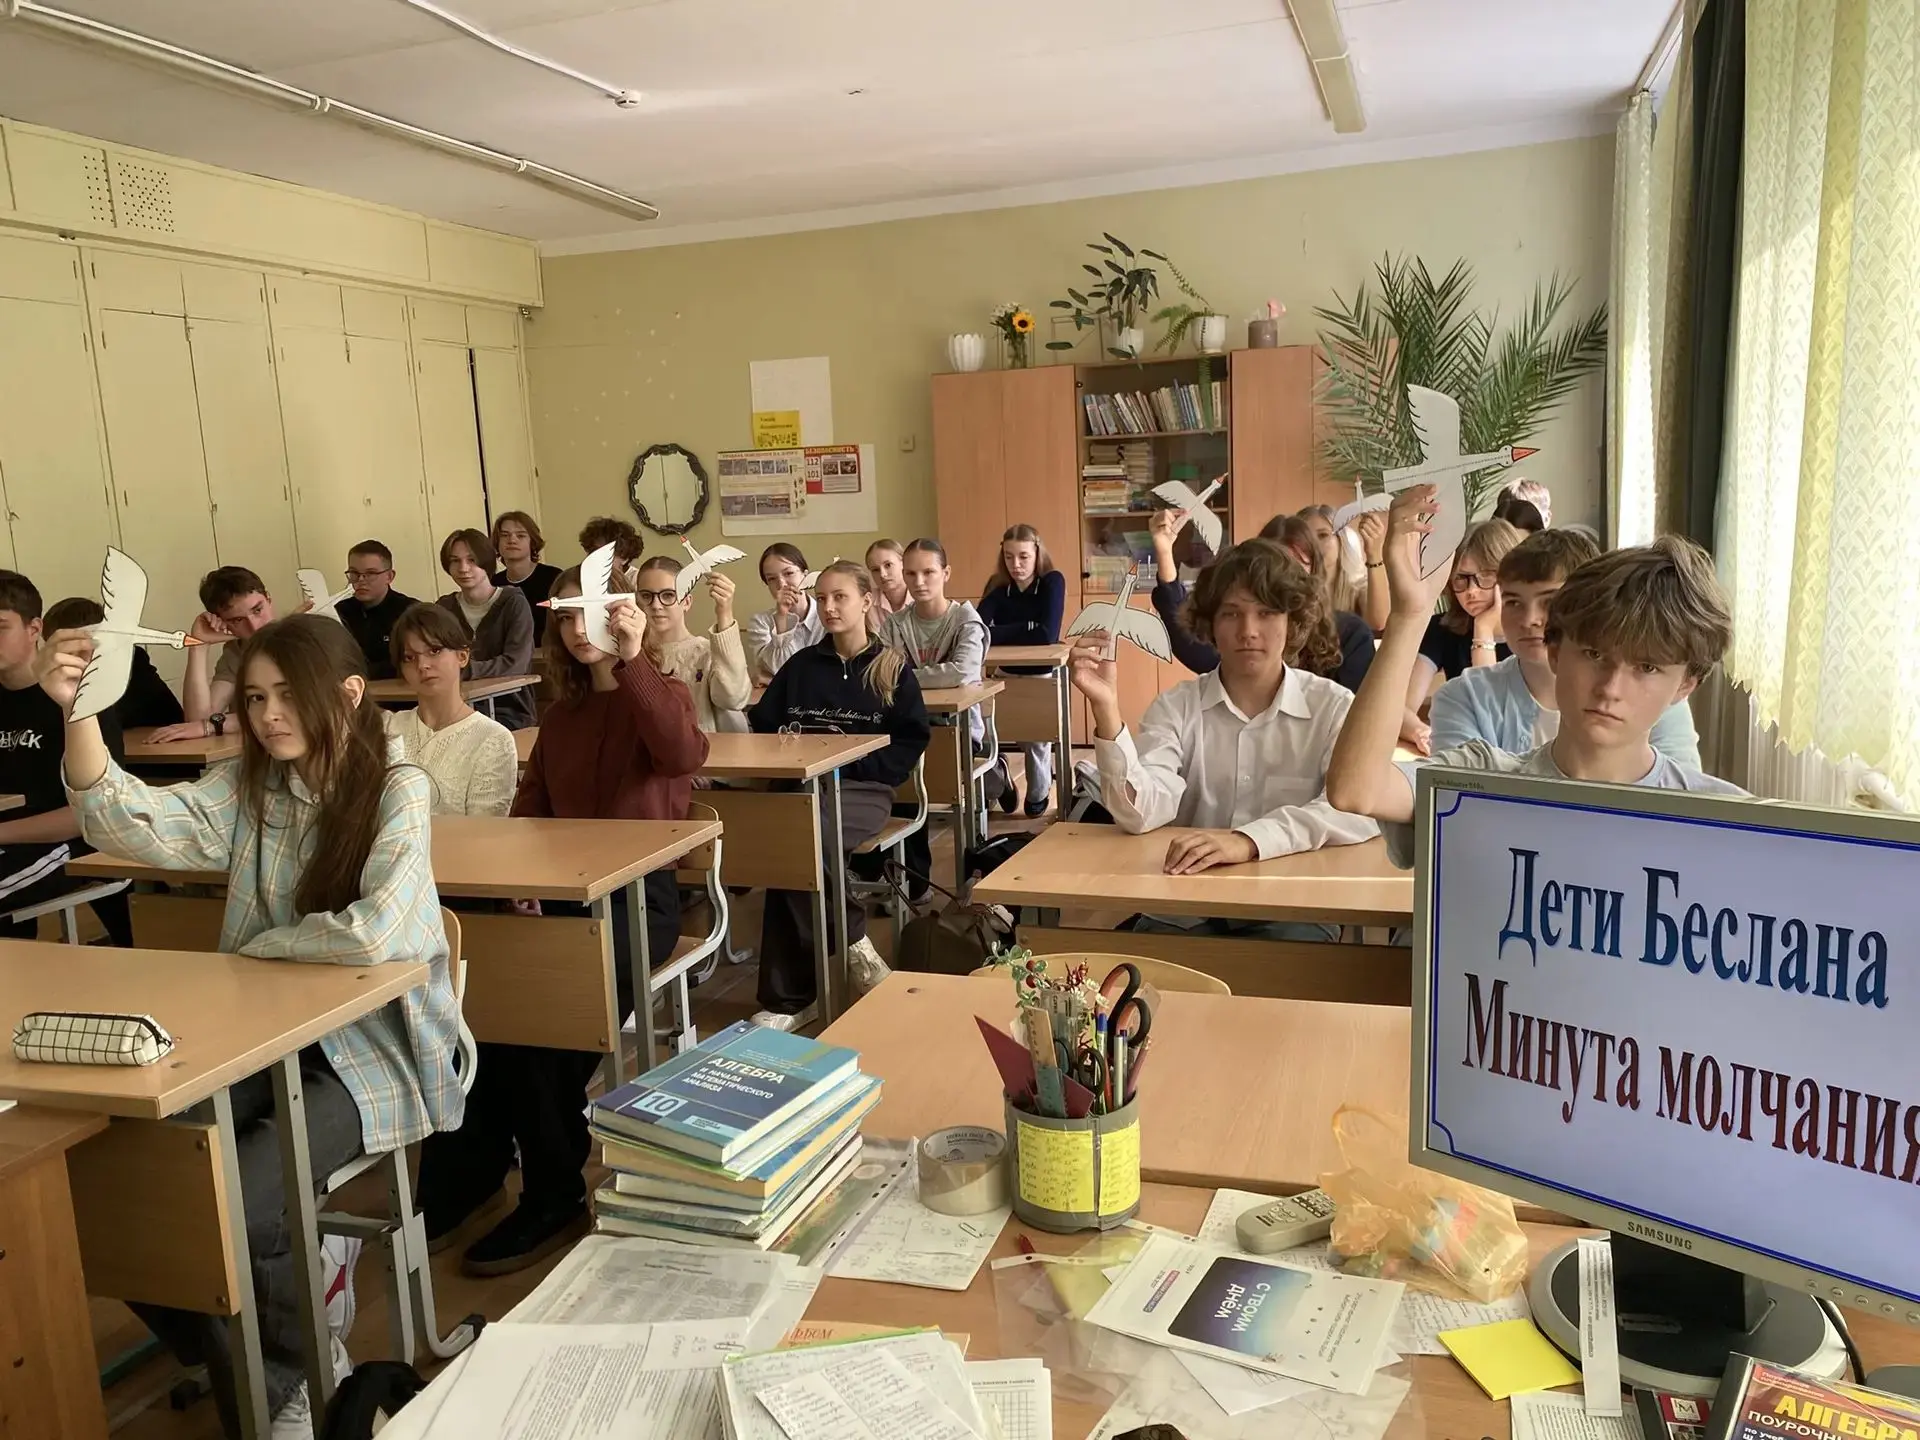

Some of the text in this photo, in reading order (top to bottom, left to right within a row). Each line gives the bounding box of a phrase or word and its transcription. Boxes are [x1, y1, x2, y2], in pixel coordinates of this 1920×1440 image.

[807, 458, 819, 466] 112
[807, 470, 819, 478] 101
[1498, 847, 1889, 1009] Дети Беслана
[681, 1077, 722, 1093] АНАЛИЗА
[690, 1071, 774, 1099] МАТЕМАТИЧЕСКОГО
[699, 1066, 742, 1083] И НАЧАЛА
[706, 1056, 787, 1085] АЛГЕБРА
[1461, 972, 1920, 1186] Минута молчания
[643, 1095, 681, 1113] 10
[1627, 1221, 1693, 1250] SAMSUNG
[1214, 1283, 1246, 1318] днём
[1231, 1293, 1267, 1332] твоим
[1747, 1410, 1845, 1440] ПОУРОЧН
